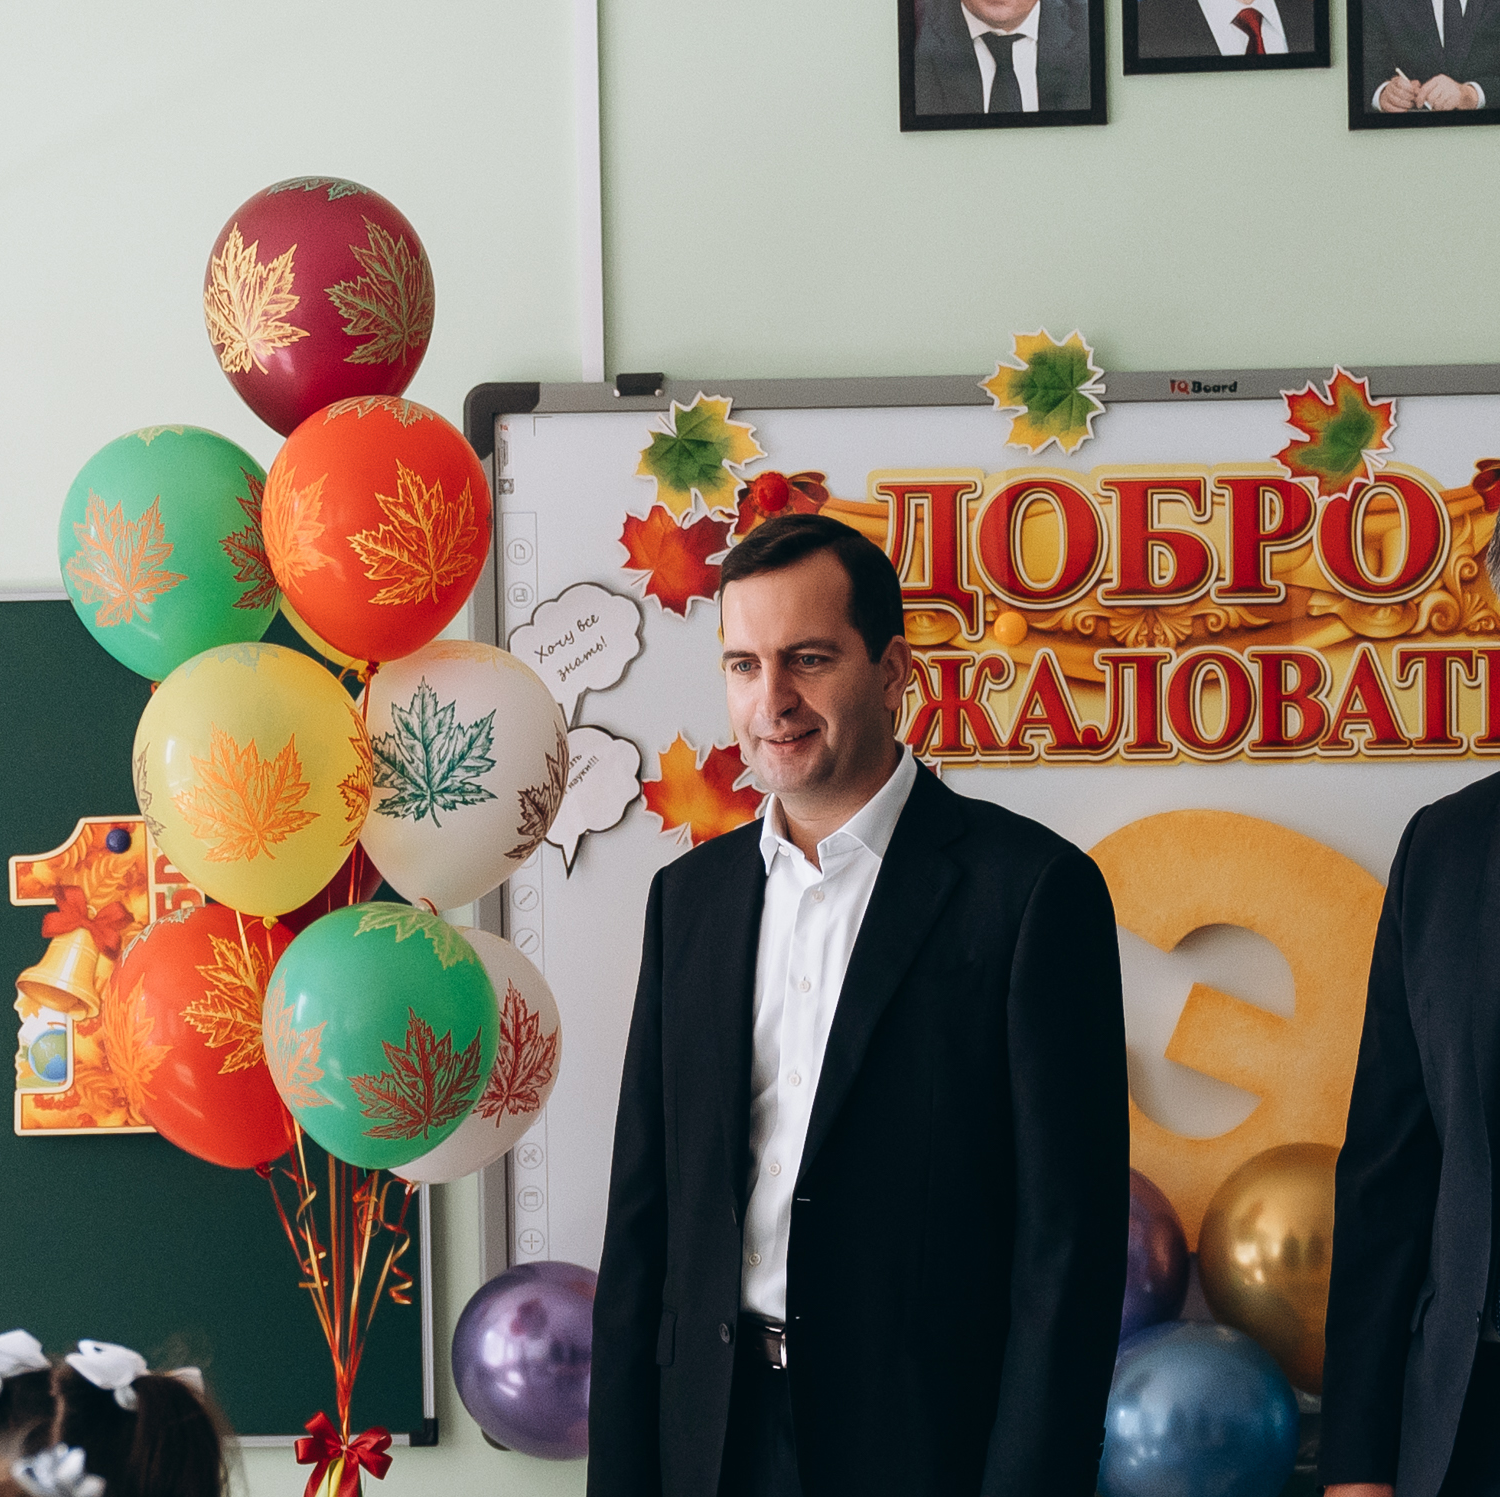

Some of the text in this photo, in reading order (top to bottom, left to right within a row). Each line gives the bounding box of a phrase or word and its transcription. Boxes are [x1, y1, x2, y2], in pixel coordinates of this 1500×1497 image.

[875, 473, 1450, 642] ДОБРО
[534, 615, 599, 664] Хочу все
[557, 635, 608, 682] знать!
